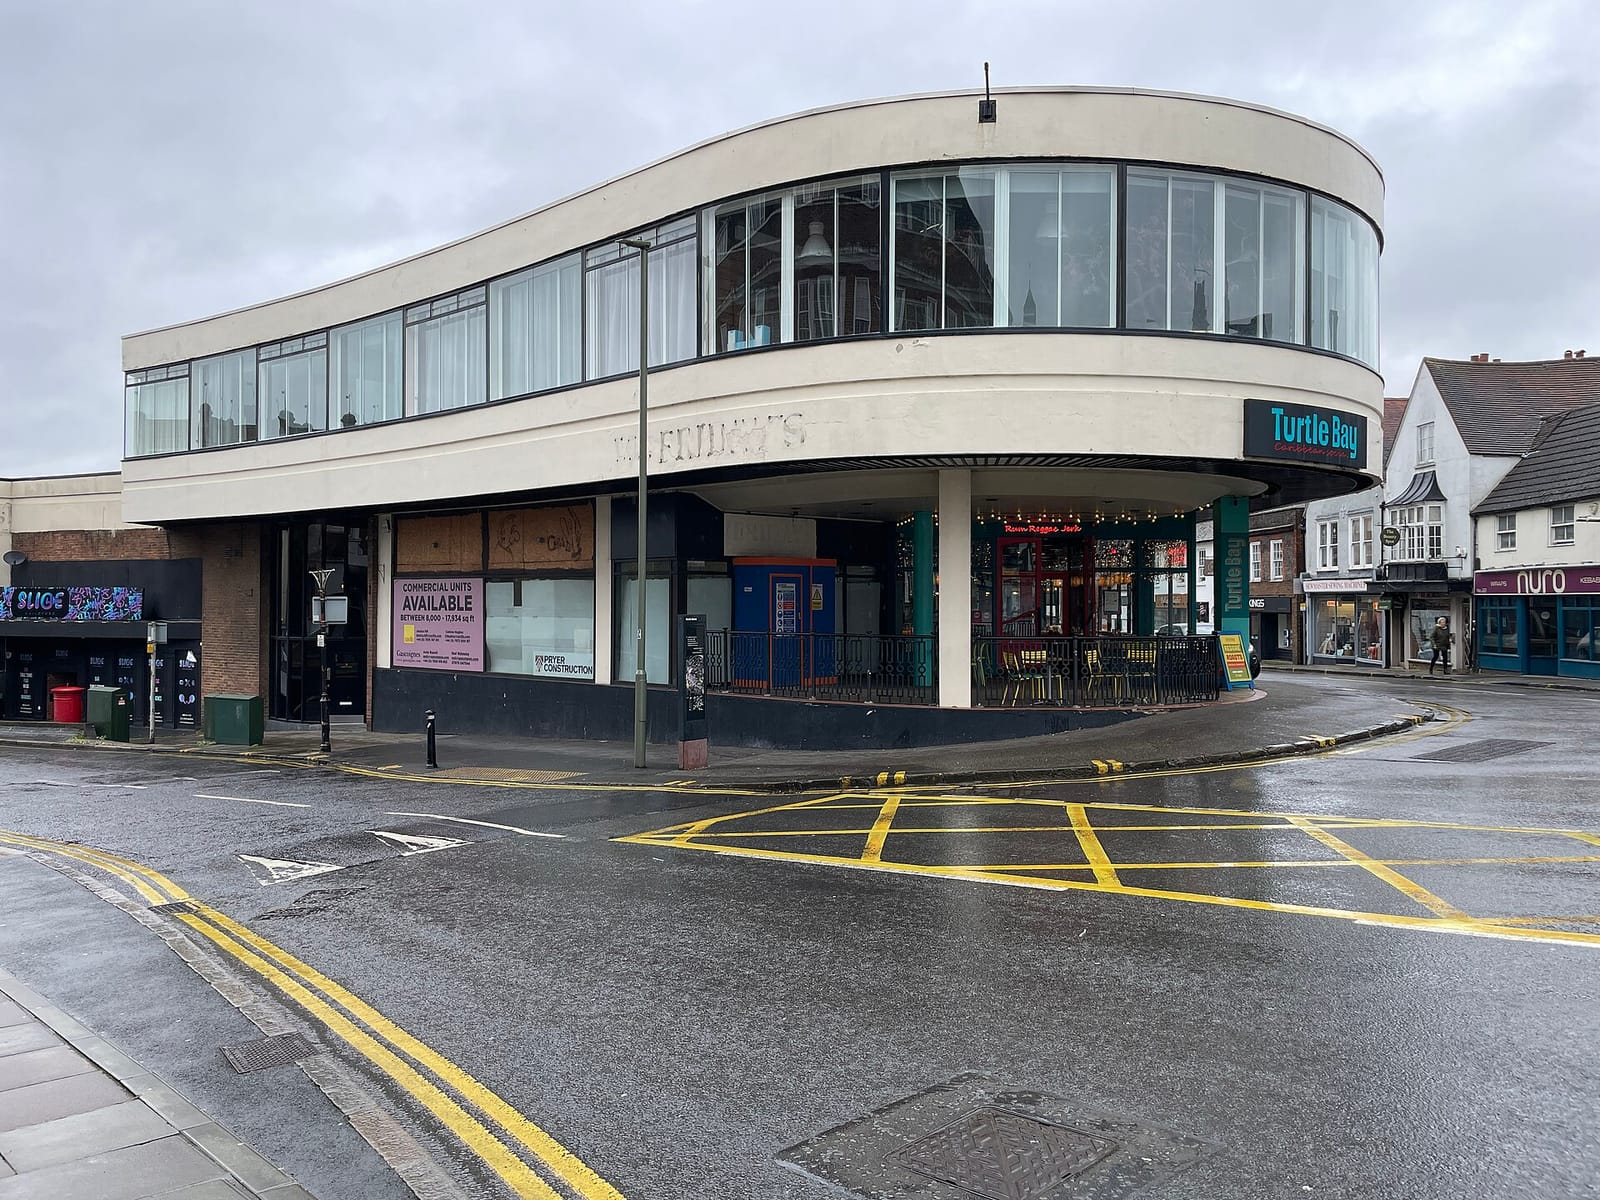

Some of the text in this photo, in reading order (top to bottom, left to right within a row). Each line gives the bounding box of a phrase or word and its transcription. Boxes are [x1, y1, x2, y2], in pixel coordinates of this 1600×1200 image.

[1271, 407, 1358, 459] Turtle Bay
[1028, 525, 1059, 534] Reggae
[1060, 524, 1082, 532] Jerk
[1224, 537, 1246, 612] Turtle Bay
[1517, 569, 1566, 594] nuro
[403, 582, 472, 592] COMMERCIAL UNITS
[402, 595, 473, 611] AVAILABLE
[426, 614, 441, 622] 8,000
[544, 655, 565, 664] PRYER
[544, 664, 592, 674] CONSTRUCTION
